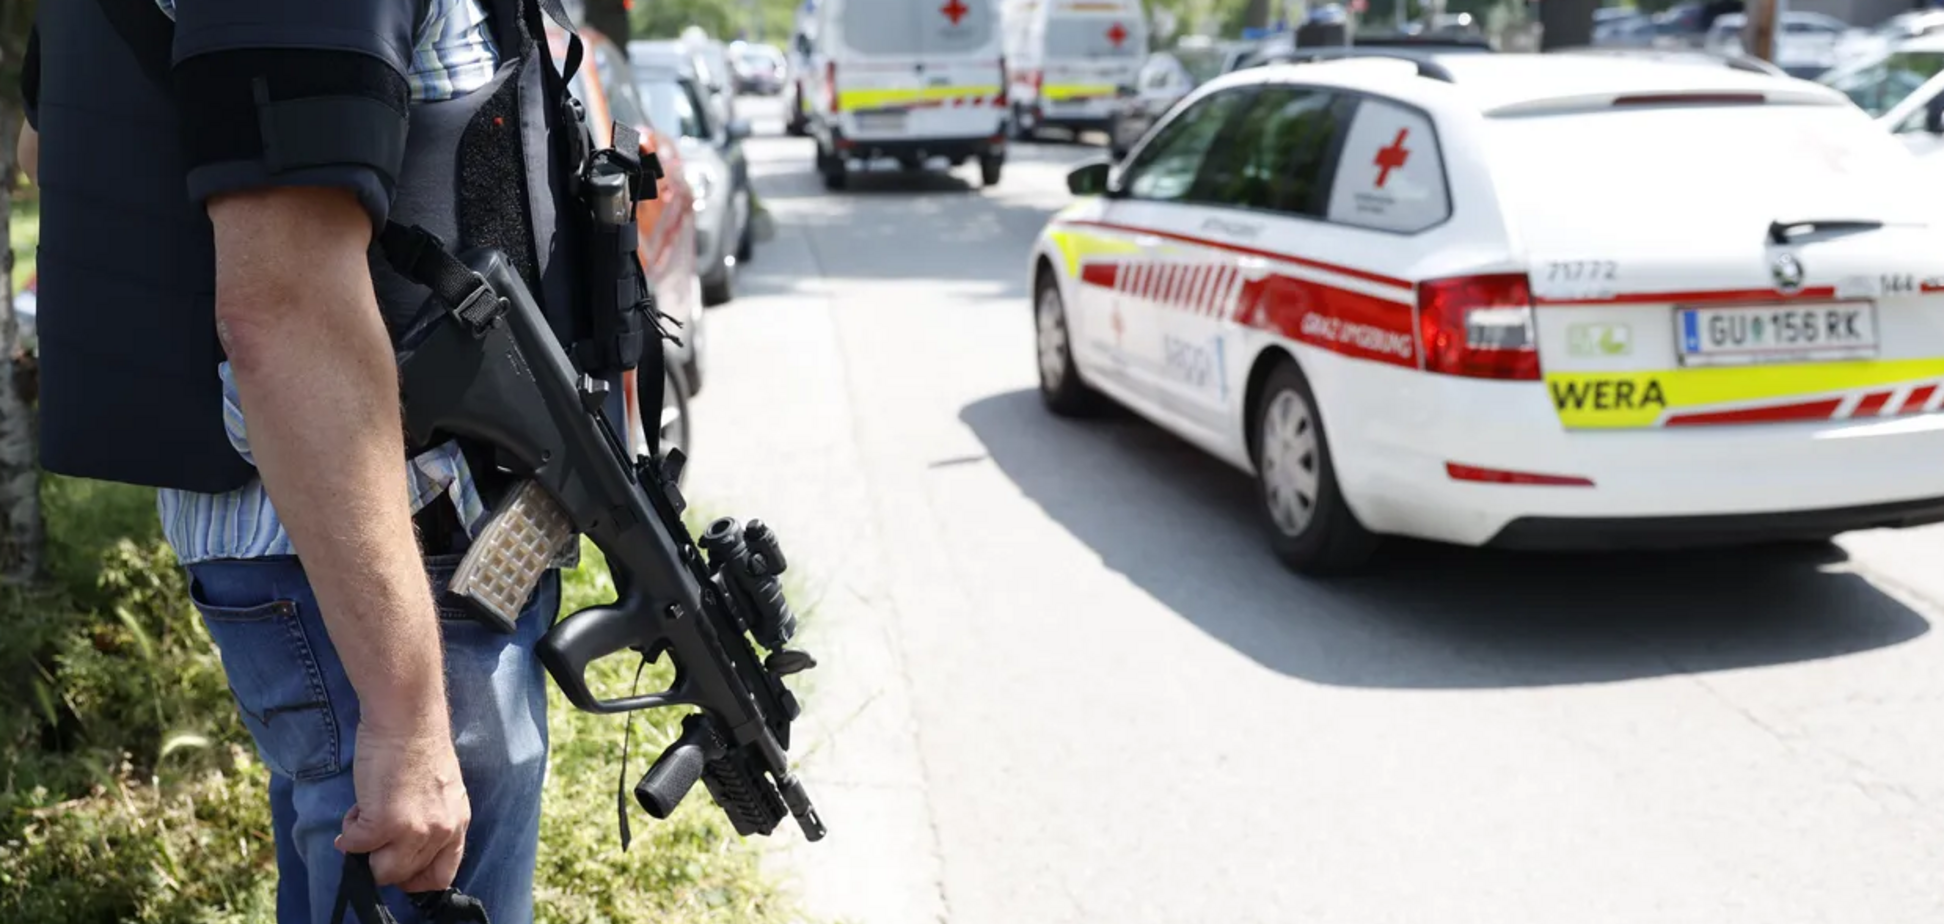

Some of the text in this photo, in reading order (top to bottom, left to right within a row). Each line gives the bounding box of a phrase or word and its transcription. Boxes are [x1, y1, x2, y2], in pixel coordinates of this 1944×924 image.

[1548, 260, 1618, 281] 71772
[1880, 273, 1914, 295] 144
[1708, 310, 1861, 346] GU 156 RK
[1551, 380, 1667, 411] WERA
